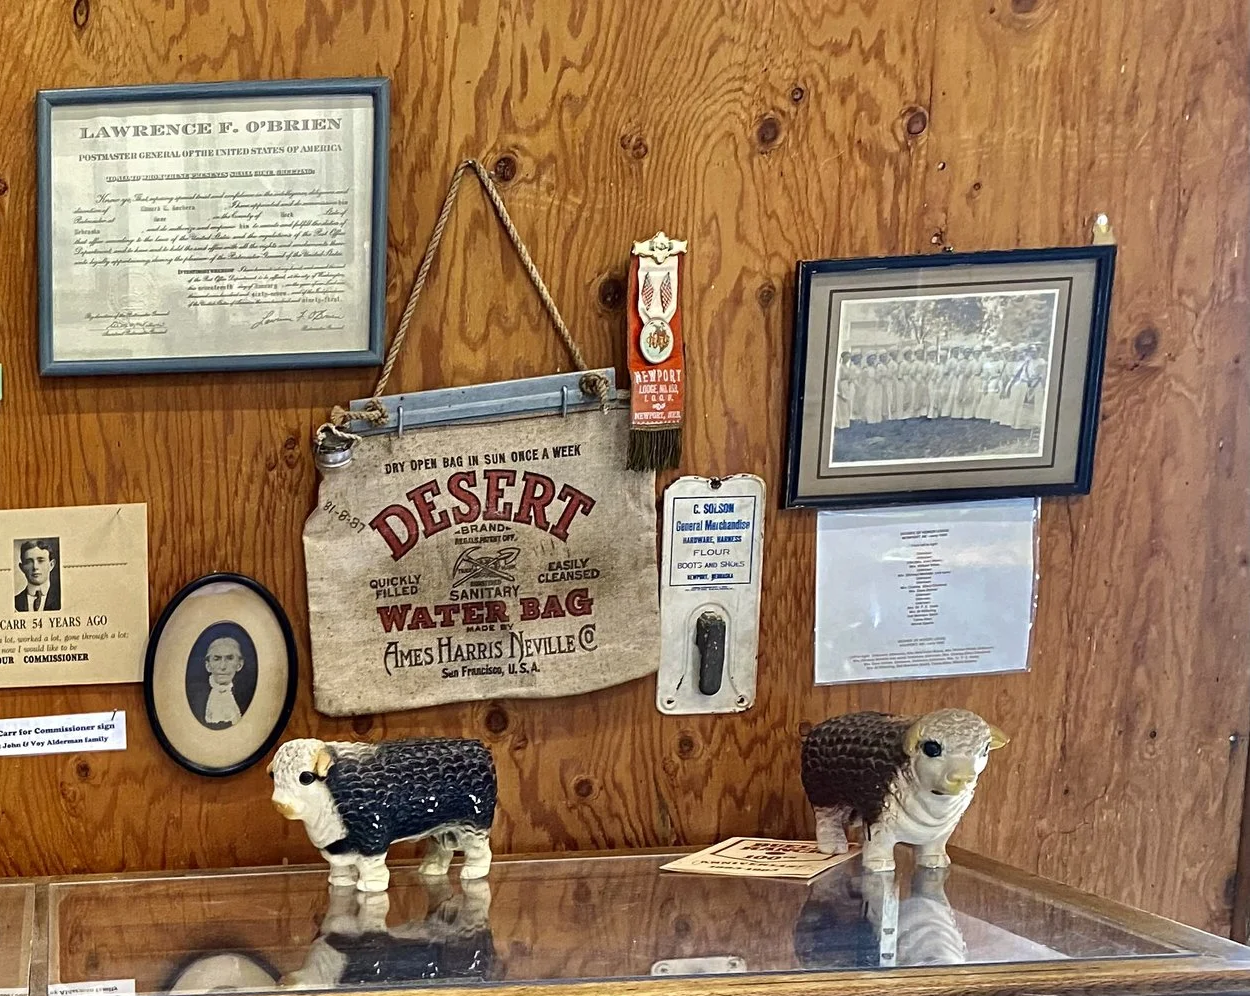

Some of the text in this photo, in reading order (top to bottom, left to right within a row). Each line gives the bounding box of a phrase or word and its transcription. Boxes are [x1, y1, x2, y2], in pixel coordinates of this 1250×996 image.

[80, 118, 343, 139] LAWRENCE F. O'BRIEN
[78, 153, 137, 162] POSTMASTER
[139, 151, 181, 159] GENERAL
[250, 147, 284, 155] STATES
[300, 145, 343, 153] AMERICA
[634, 369, 681, 384] NEWPORT
[385, 444, 581, 474] DRY OPEN BAG IN SUN ONCE A WEEK
[369, 468, 597, 562] DESERT
[694, 503, 734, 514] C. SOLSON
[461, 524, 505, 534] BRAND
[676, 520, 750, 531] General Merchandise
[548, 558, 589, 571] EASILY
[369, 575, 421, 589] QUICKLY
[538, 569, 600, 583] CLEANSED
[376, 586, 418, 599] FILLED
[450, 585, 520, 601] SANITARY
[376, 588, 594, 632] WATER BAG
[0, 619, 26, 629] CARR
[32, 618, 42, 629] 54
[49, 616, 80, 628] YEARS
[87, 615, 108, 626] AGO
[23, 653, 89, 664] COMMISSIONER
[384, 631, 575, 675] AMES HARRIS NEVILLE
[442, 664, 505, 678] San Francisco,
[34, 724, 95, 734] Commissioner
[97, 722, 115, 731] sign
